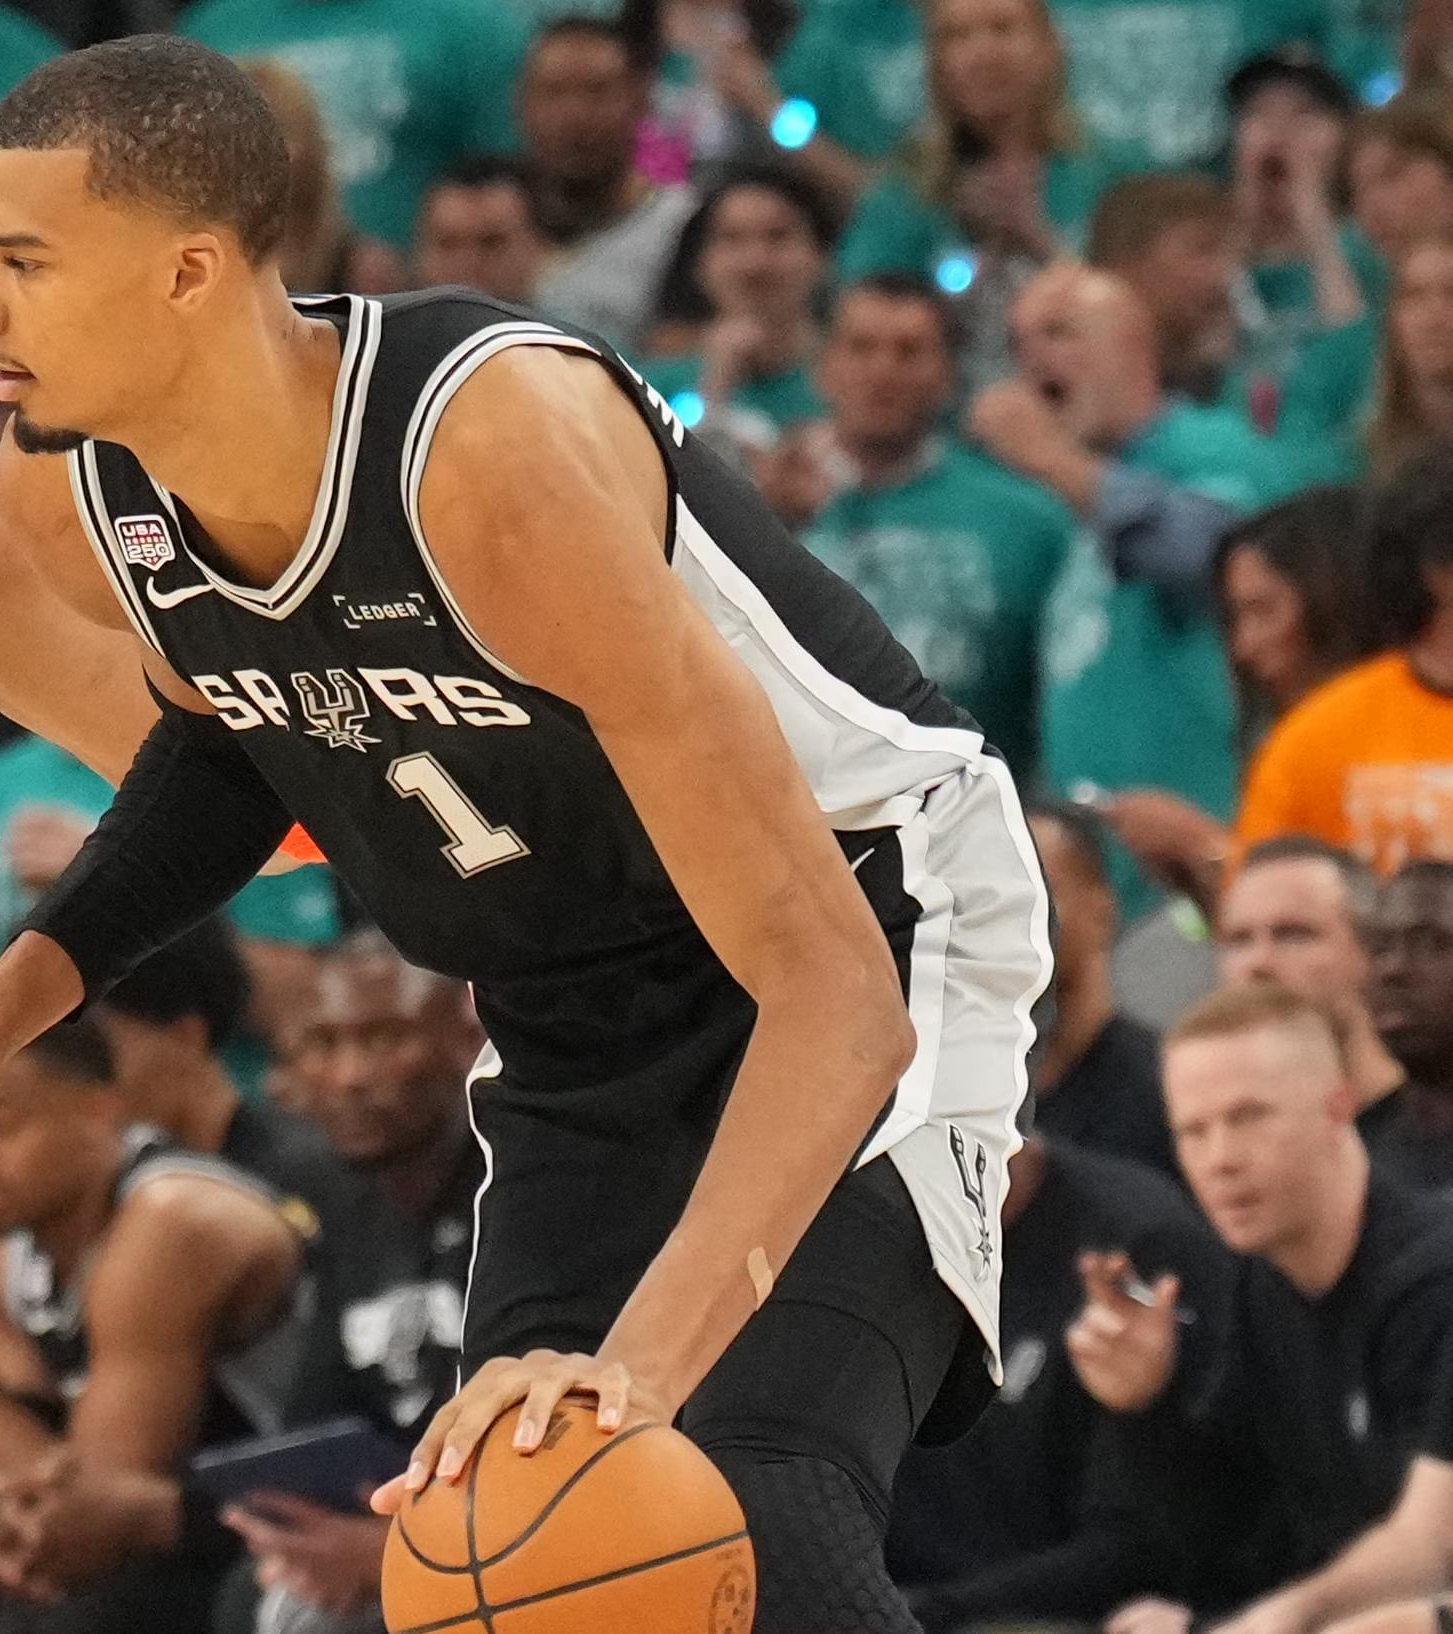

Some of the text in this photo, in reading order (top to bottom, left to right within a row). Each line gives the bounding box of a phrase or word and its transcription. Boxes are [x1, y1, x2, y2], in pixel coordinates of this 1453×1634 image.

[122, 523, 162, 536] USA
[127, 543, 170, 559] 250
[348, 602, 421, 620] LEDGER
[191, 667, 531, 753] SPURS
[385, 751, 532, 880] 1
